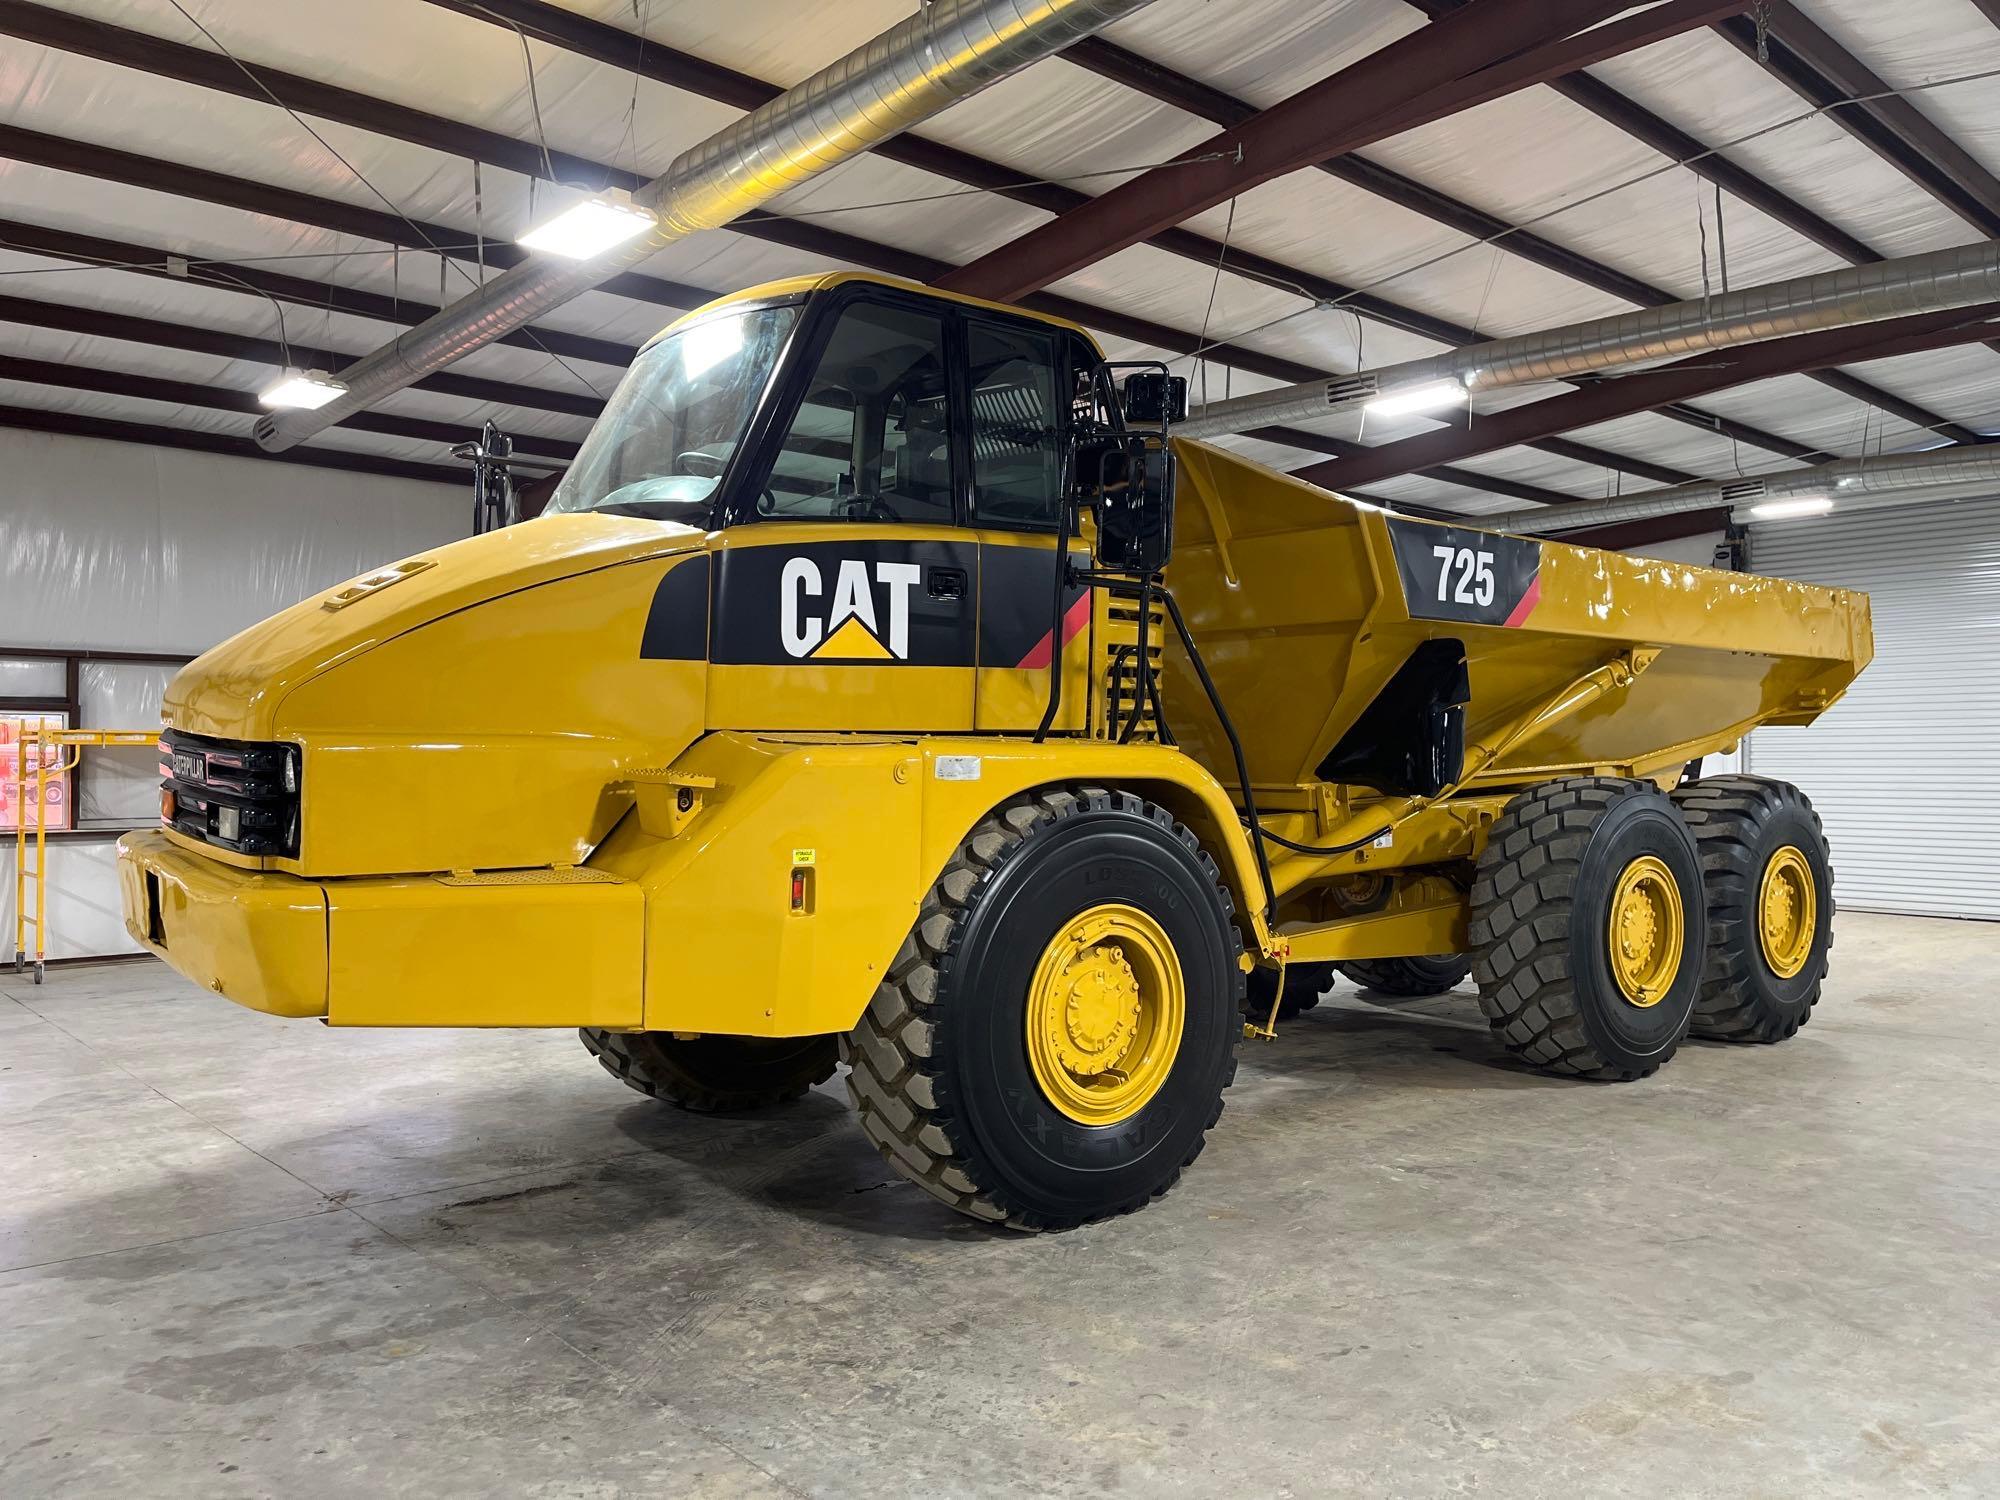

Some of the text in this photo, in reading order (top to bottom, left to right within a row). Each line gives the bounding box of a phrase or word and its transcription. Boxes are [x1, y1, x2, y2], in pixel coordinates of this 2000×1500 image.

[1433, 546, 1495, 607] 725
[781, 557, 920, 660] CAT
[173, 754, 204, 780] CATERPILLAR
